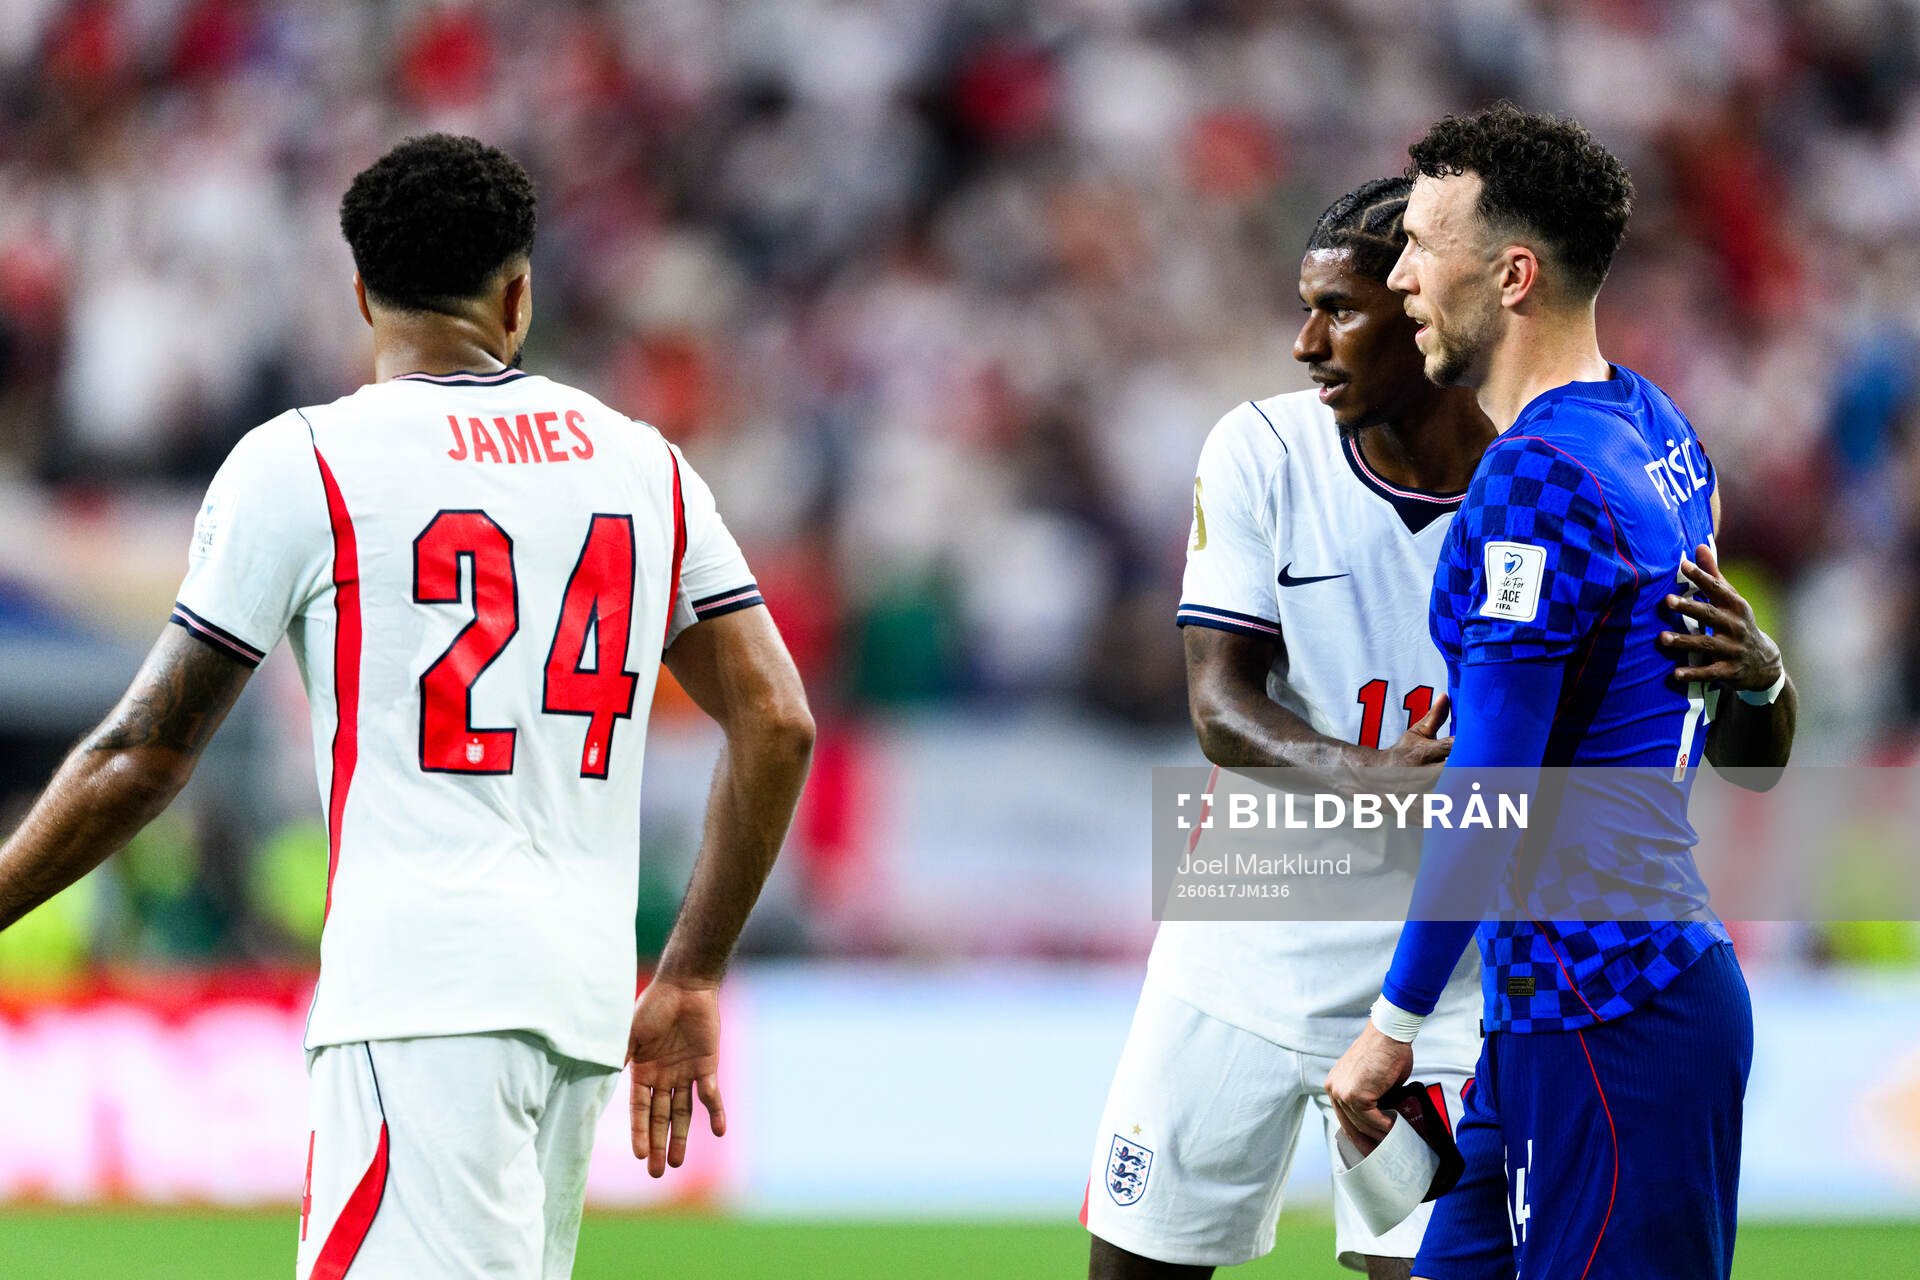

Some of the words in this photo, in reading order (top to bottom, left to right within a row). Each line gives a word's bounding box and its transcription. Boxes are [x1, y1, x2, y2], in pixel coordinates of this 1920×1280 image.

[447, 410, 594, 464] JAMES
[1495, 602, 1511, 611] FIFA
[413, 509, 639, 780] 24
[1357, 678, 1435, 750] 11
